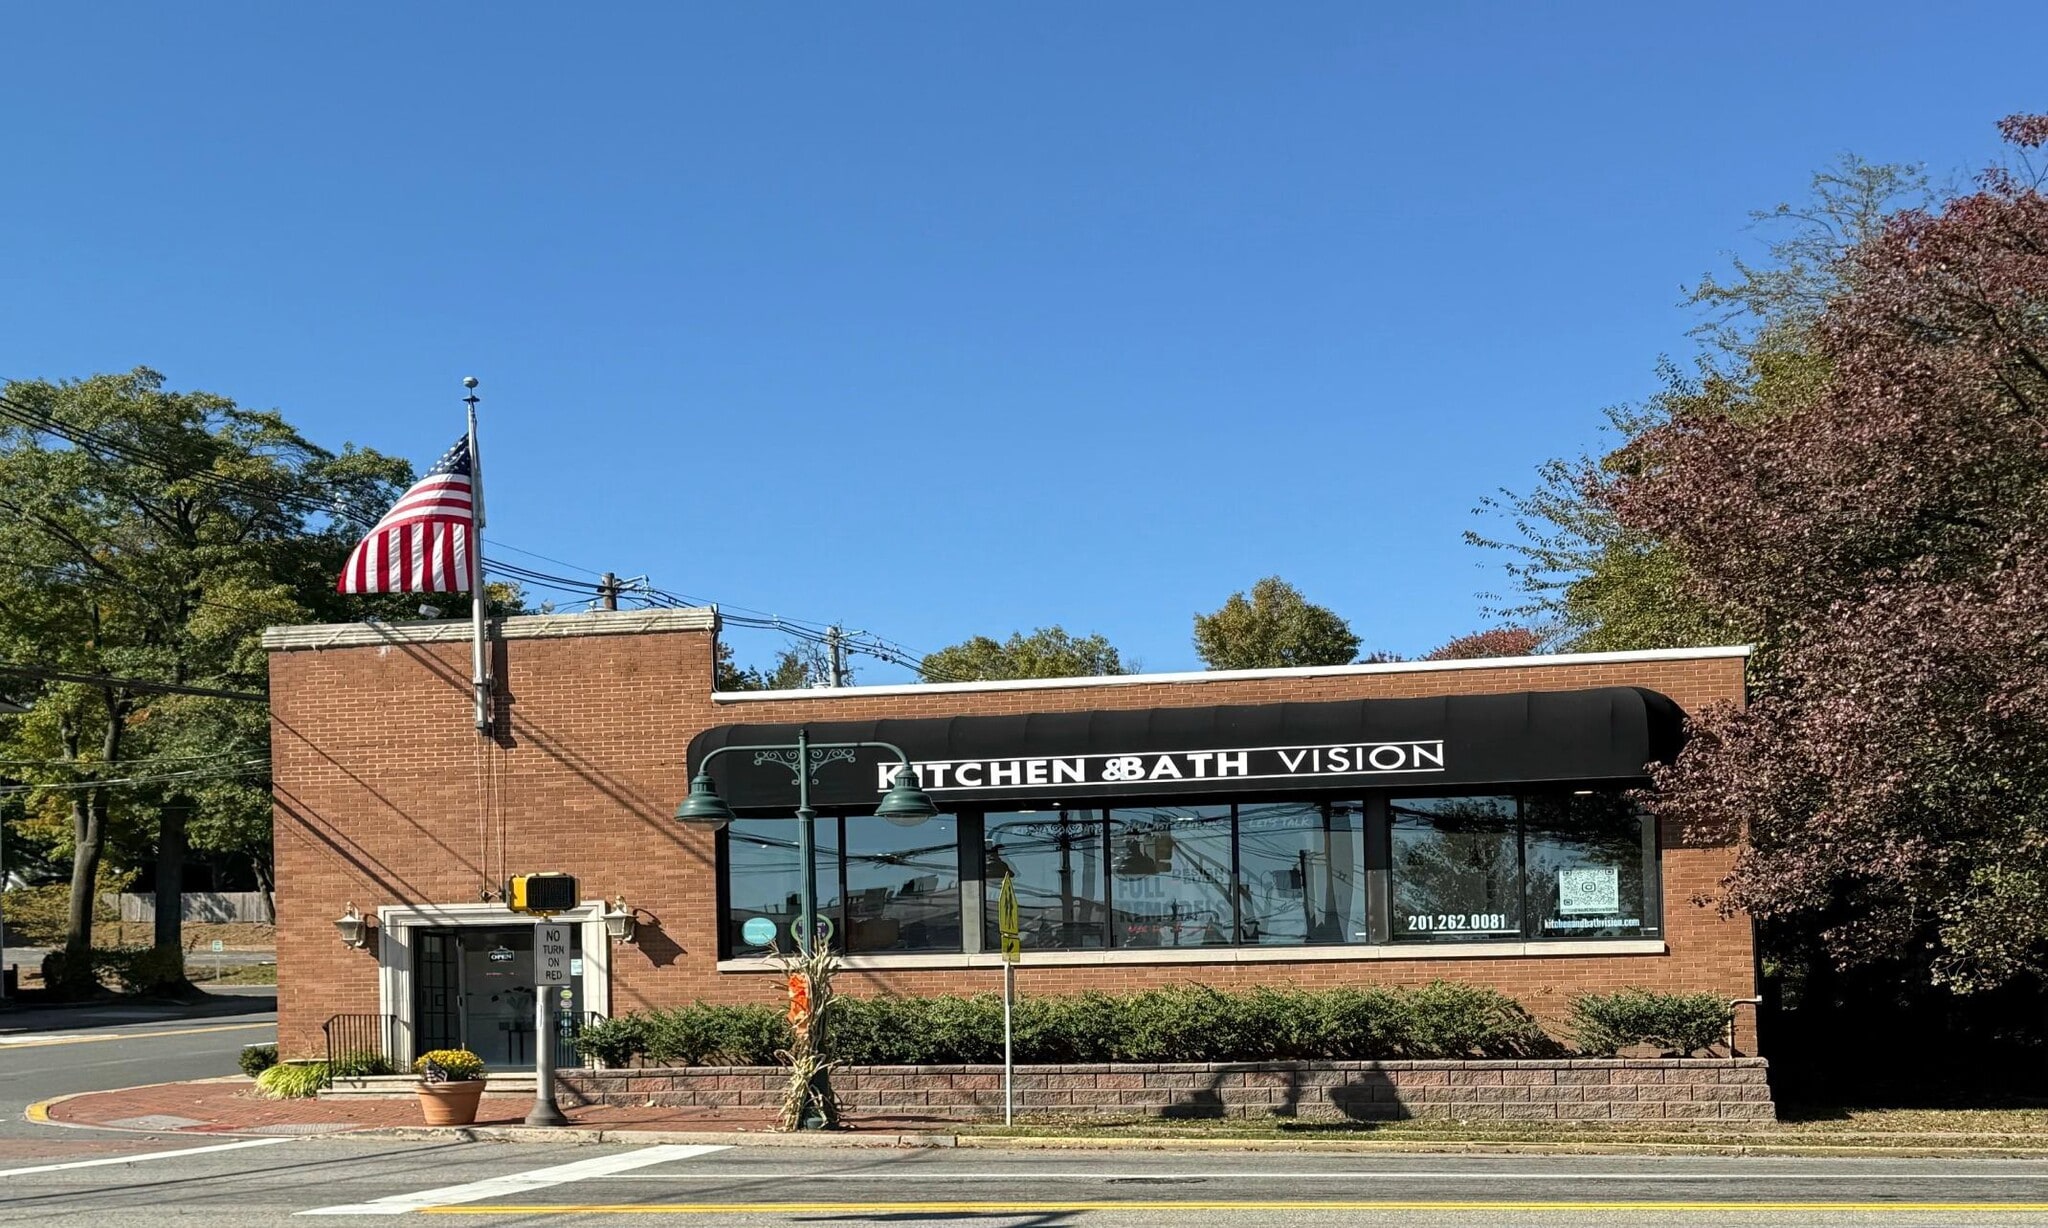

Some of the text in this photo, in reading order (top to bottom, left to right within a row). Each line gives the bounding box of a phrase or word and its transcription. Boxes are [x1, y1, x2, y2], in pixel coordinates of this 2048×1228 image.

[878, 758, 1085, 789] KITCHEN
[1277, 743, 1444, 773] VISION
[1408, 914, 1505, 930] 201.262.0081
[546, 930, 560, 942] NO
[543, 945, 564, 954] TURN
[548, 957, 560, 967] ON
[545, 970, 563, 980] RED
